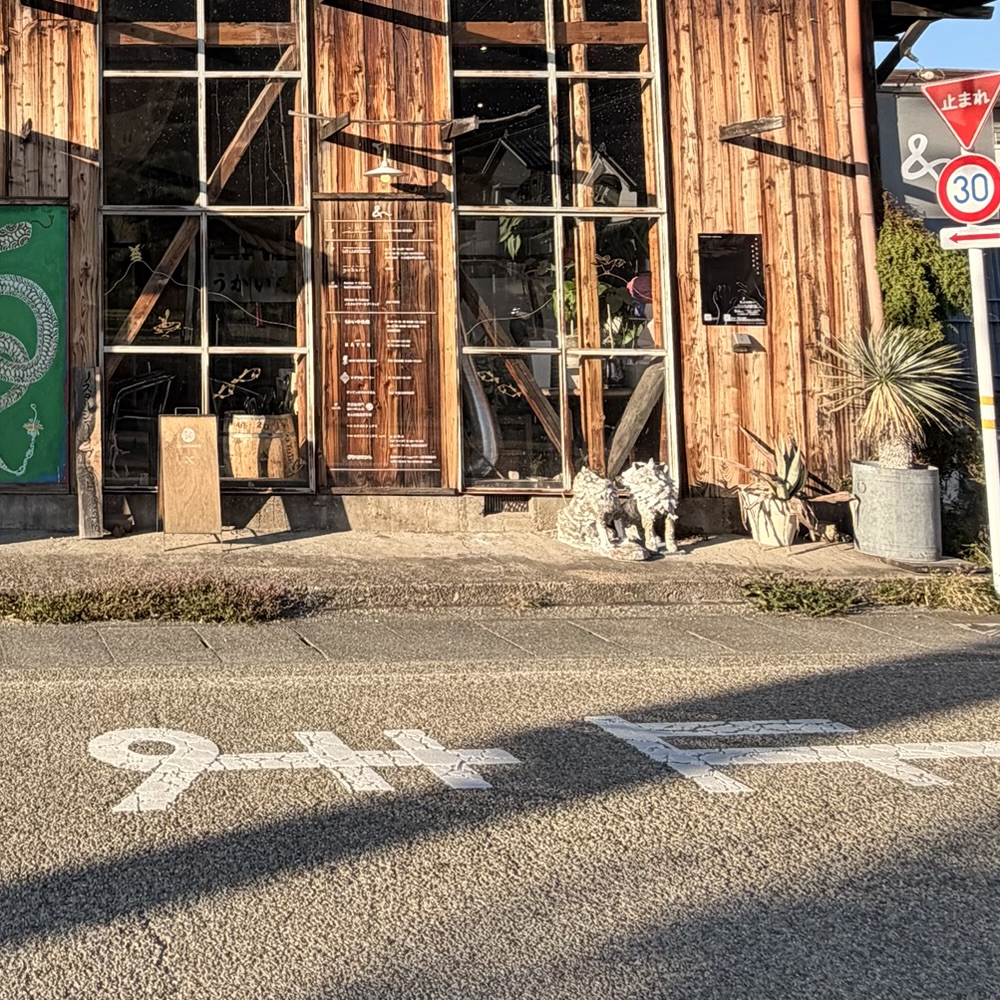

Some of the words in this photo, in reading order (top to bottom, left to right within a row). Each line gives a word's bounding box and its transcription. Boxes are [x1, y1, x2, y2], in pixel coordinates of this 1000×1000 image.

[941, 89, 990, 111] 止まれ
[953, 173, 989, 204] 30
